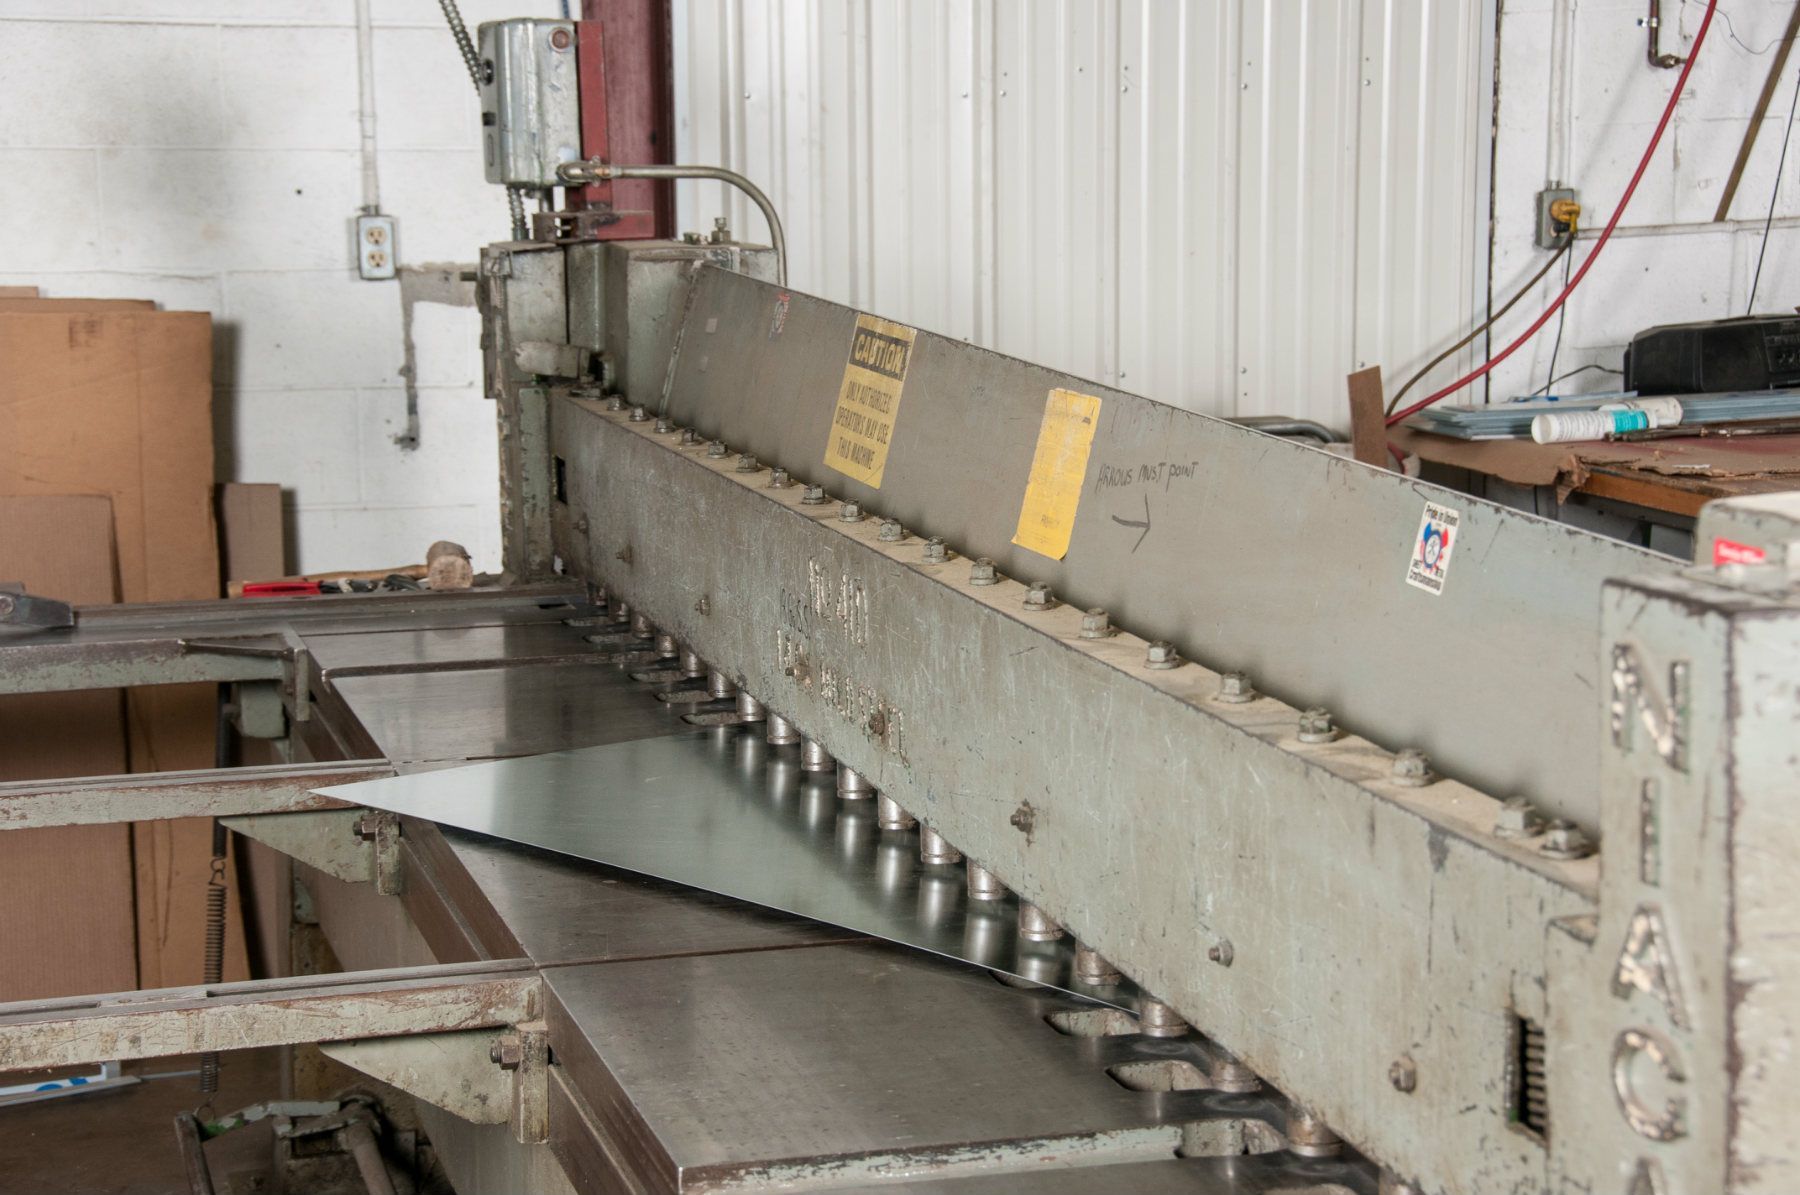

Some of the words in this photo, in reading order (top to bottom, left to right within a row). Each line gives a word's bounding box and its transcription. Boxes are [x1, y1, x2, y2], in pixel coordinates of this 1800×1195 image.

[855, 334, 906, 373] CAUTION
[846, 381, 860, 403] ONLY
[859, 385, 893, 415] AUTHORIZED
[835, 406, 867, 436] OPERATORS
[866, 414, 879, 440] MAY
[876, 422, 890, 445] USE
[836, 437, 852, 460] THIS
[850, 442, 876, 470] MACHINE
